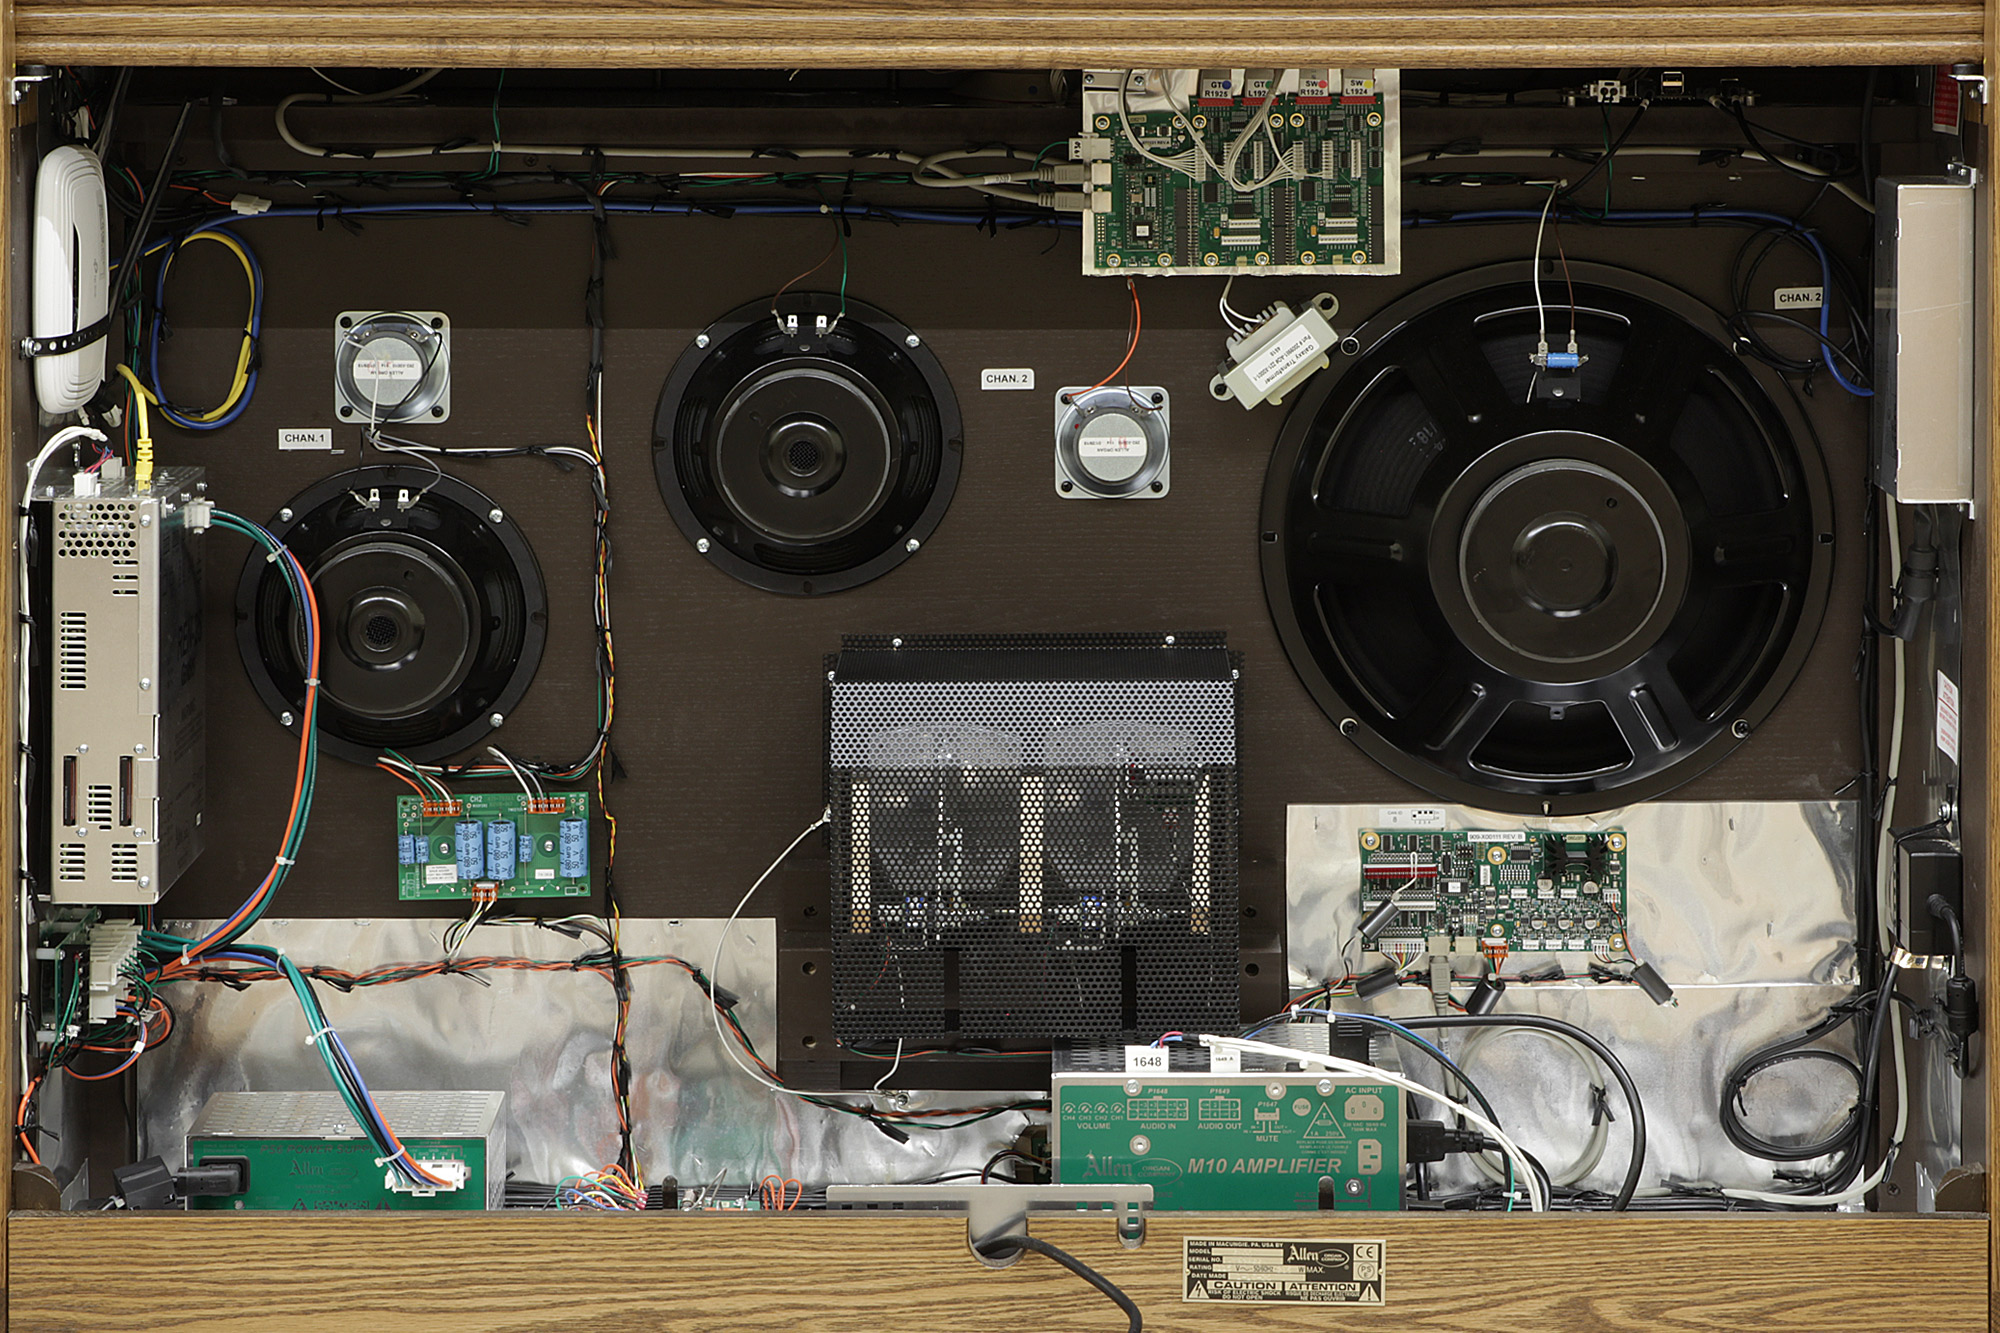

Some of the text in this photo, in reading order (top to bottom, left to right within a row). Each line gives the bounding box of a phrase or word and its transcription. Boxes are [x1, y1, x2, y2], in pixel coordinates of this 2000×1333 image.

[1305, 80, 1319, 88] SW
[1204, 90, 1228, 98] R1925
[1779, 292, 1822, 302] CHAN. 2
[1296, 344, 1314, 360] Galaxy
[1264, 358, 1297, 384] Transformer
[986, 374, 1028, 383] CHAN. 2
[284, 434, 324, 442] CHAN. 1
[1133, 1057, 1162, 1067] 1648
[287, 1144, 334, 1154] POWER
[336, 1144, 377, 1154] SUPPL
[1082, 1149, 1132, 1178] Allen
[1188, 1158, 1342, 1174] M10 AMPLIFIER
[1287, 1243, 1319, 1263] Allen
[1290, 1283, 1356, 1291] ATTENTION
